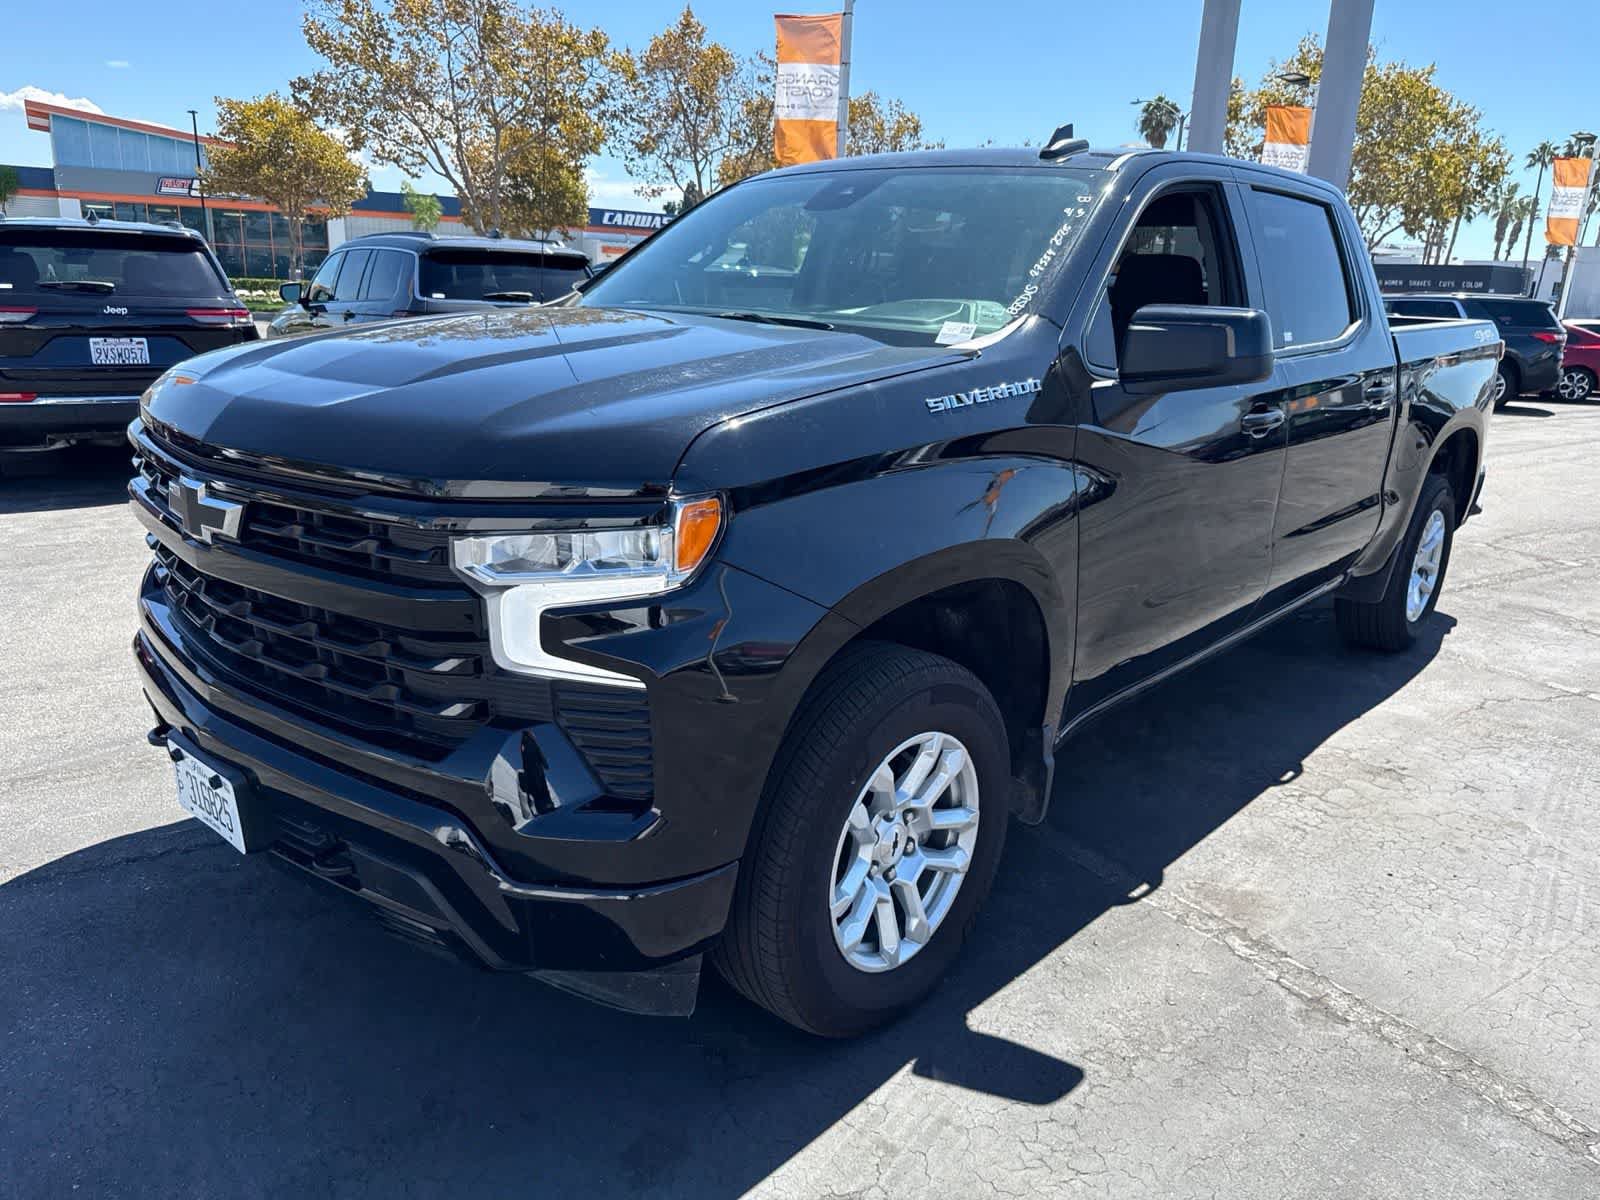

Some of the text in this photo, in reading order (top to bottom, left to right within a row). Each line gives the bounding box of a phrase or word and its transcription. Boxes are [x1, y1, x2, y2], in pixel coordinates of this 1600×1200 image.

[1438, 280, 1455, 288] CUTS
[1461, 281, 1483, 289] COLOR
[103, 305, 128, 316] Jeep
[925, 377, 1042, 414] SILVERADO
